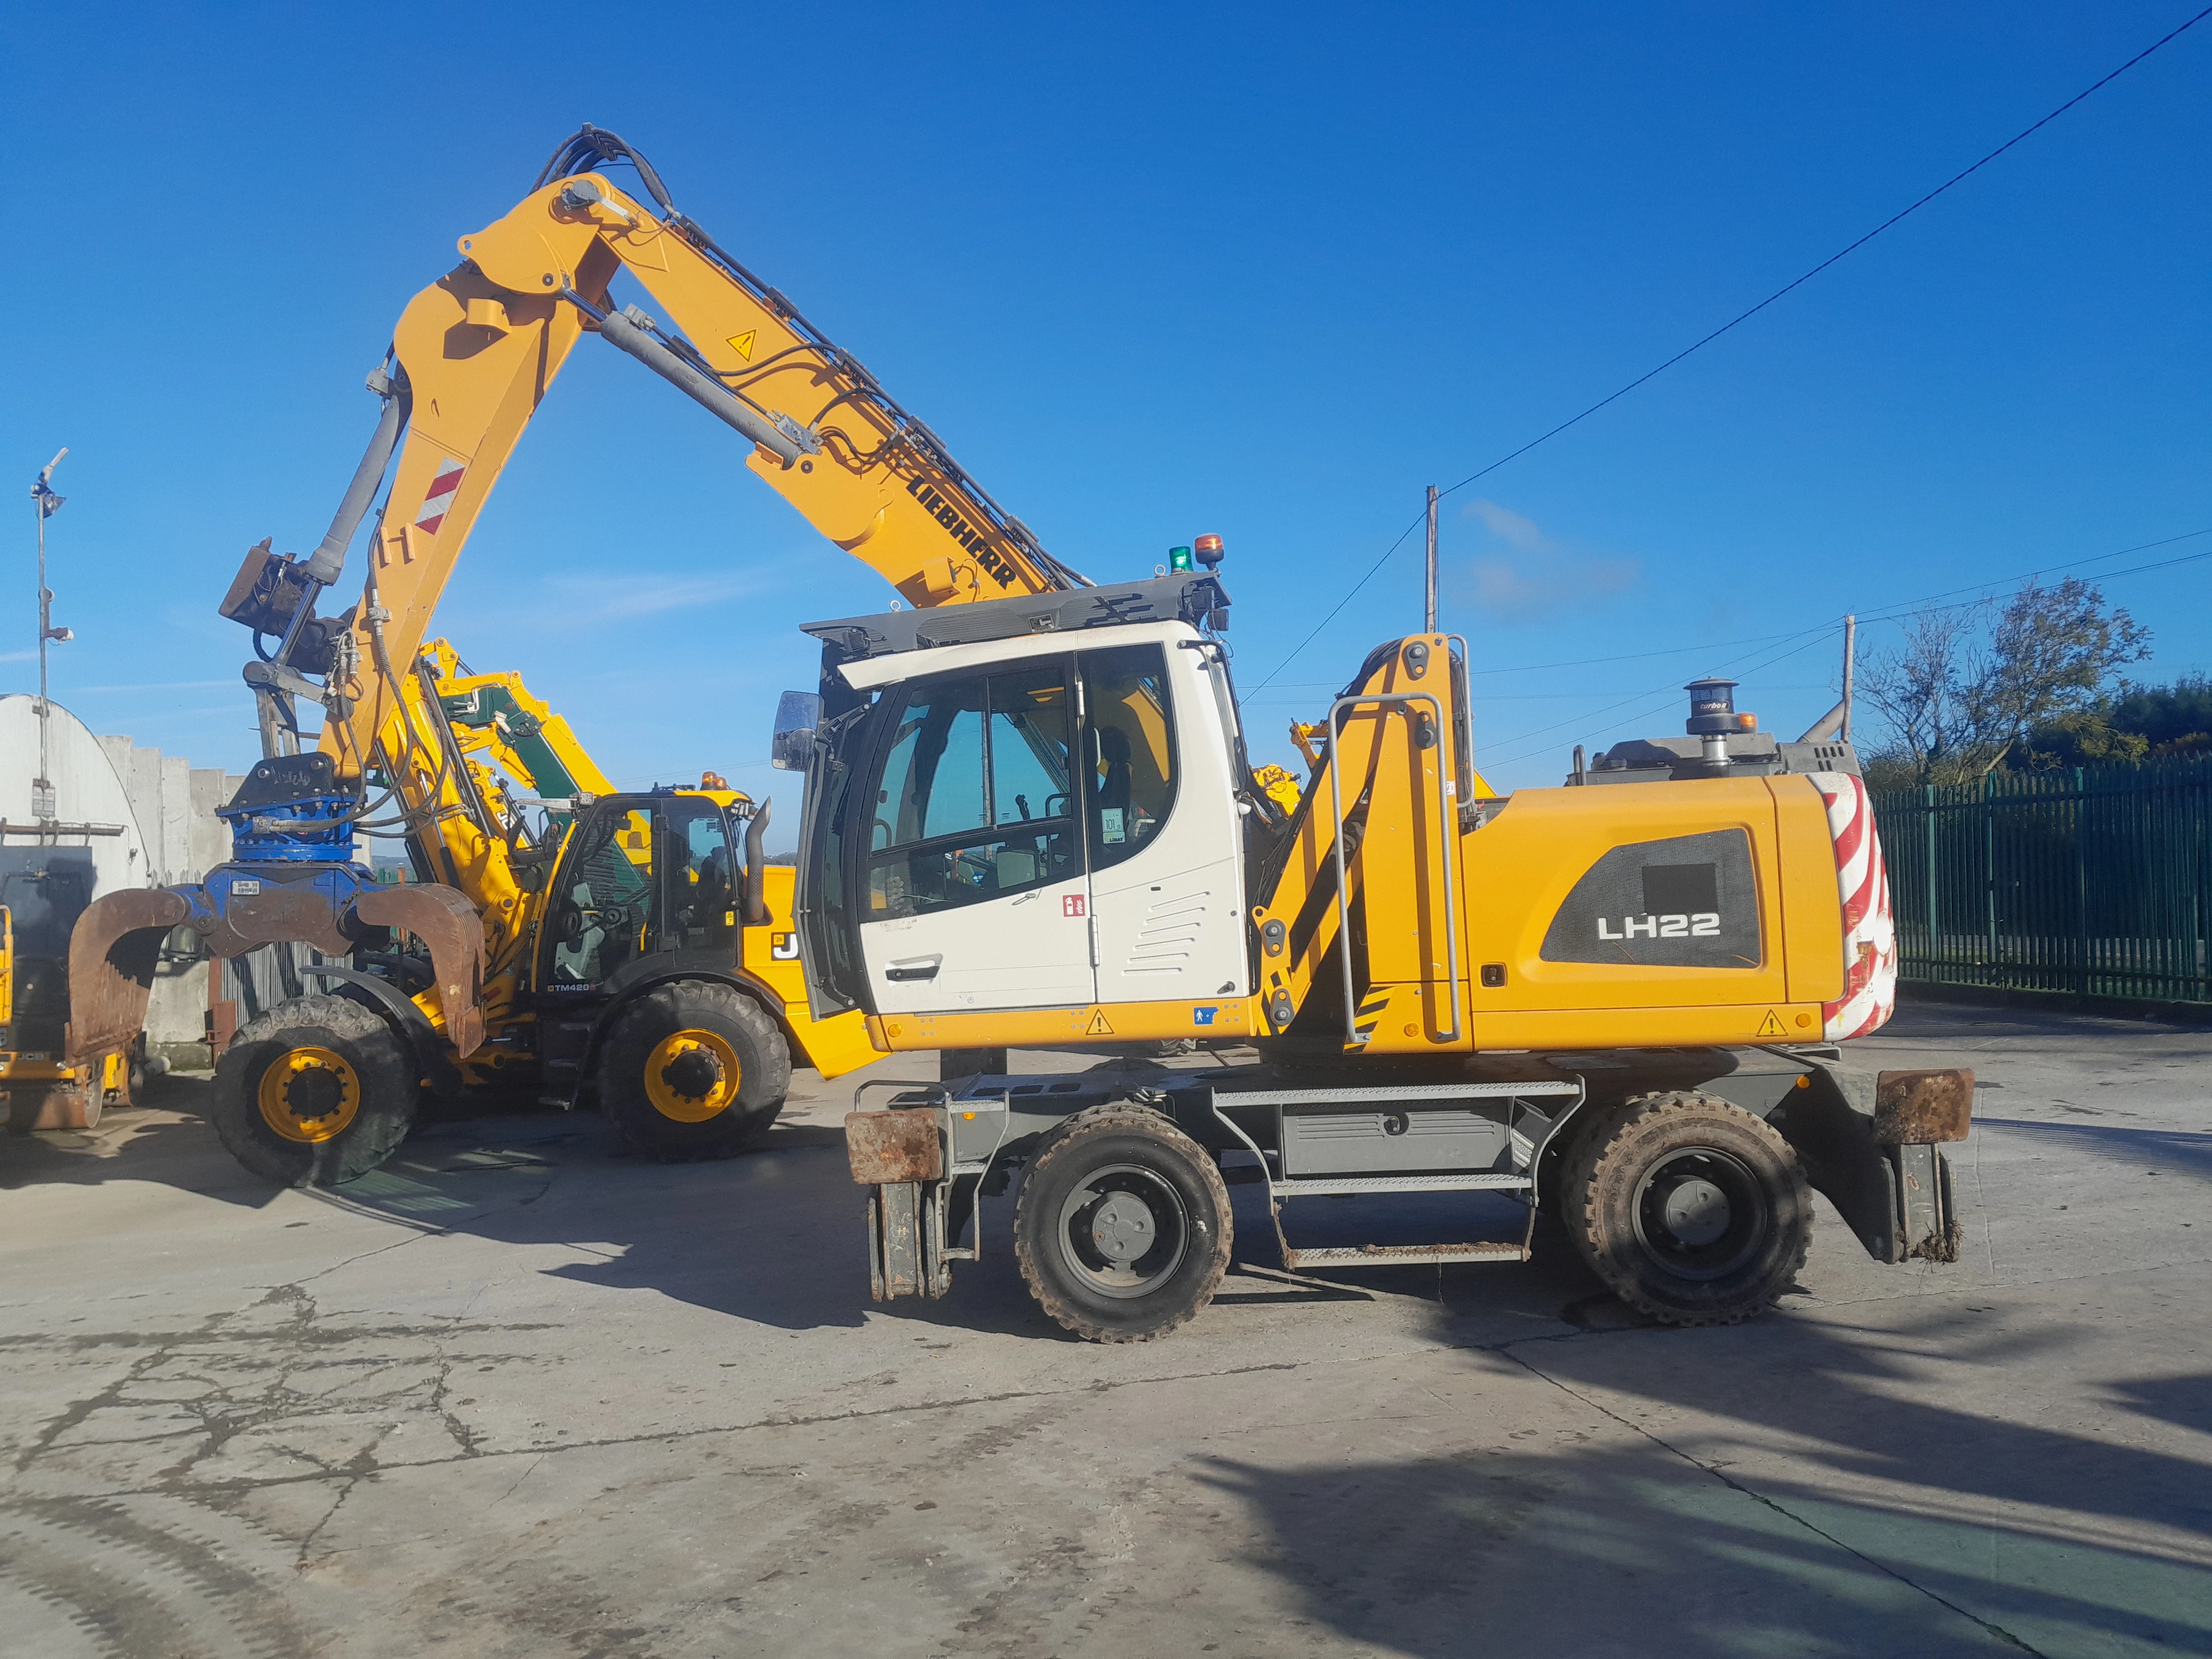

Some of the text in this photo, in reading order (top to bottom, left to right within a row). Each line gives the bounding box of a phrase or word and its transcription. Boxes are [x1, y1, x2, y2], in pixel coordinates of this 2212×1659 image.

[906, 474, 1016, 590] LIEBHERR
[1106, 819, 1115, 830] 101
[1598, 913, 1720, 939] LH22
